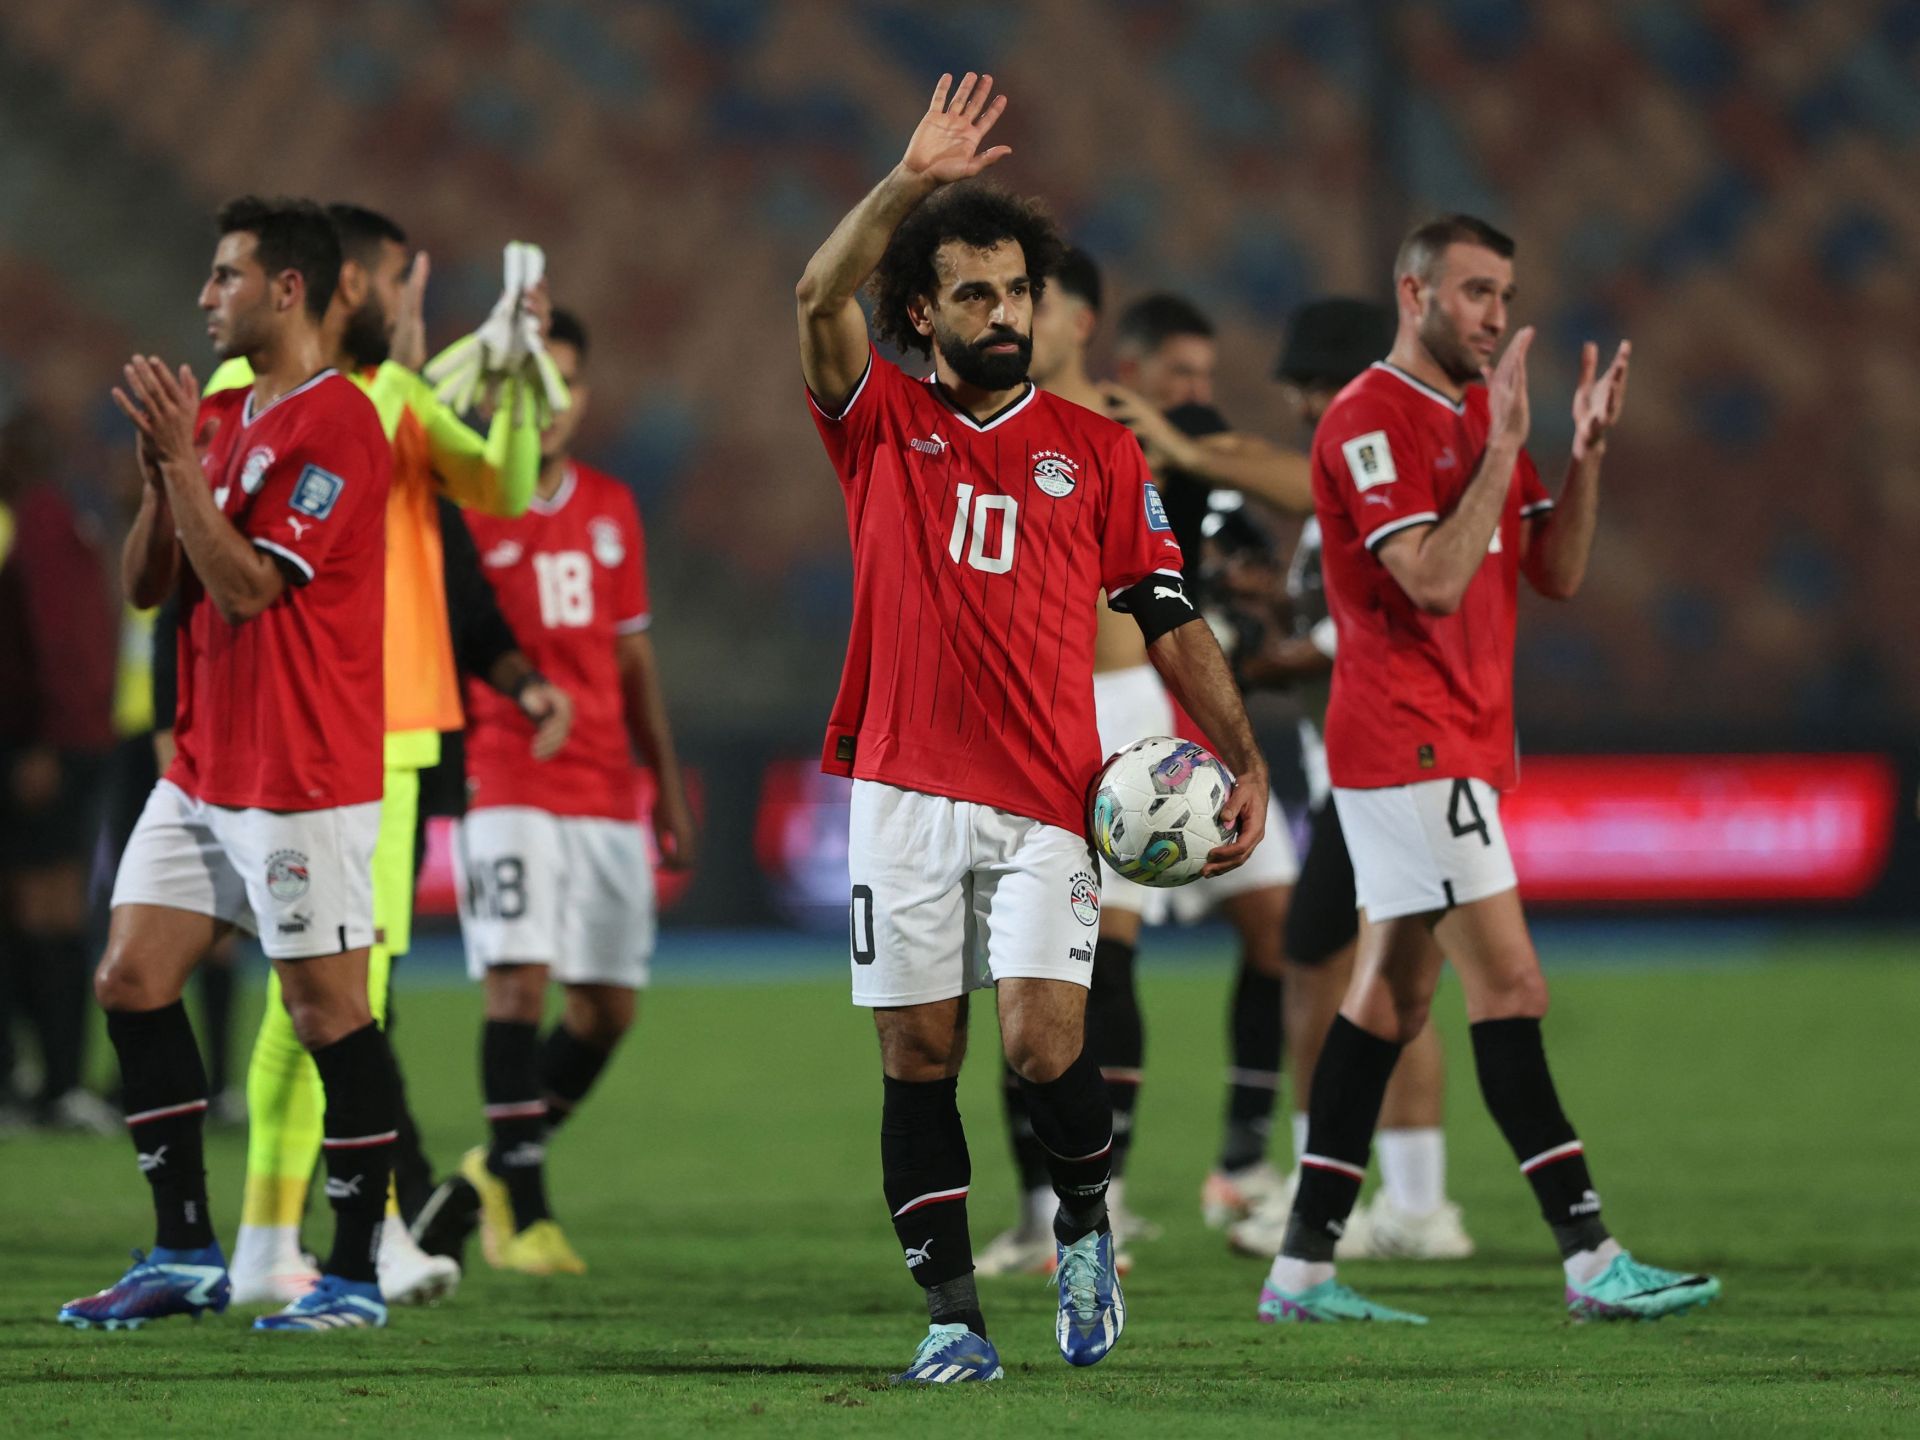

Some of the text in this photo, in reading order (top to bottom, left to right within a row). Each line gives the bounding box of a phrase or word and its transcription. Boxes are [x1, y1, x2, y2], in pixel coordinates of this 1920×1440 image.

[949, 482, 1018, 574] 10
[532, 551, 595, 629] 18
[1448, 777, 1491, 846] 4
